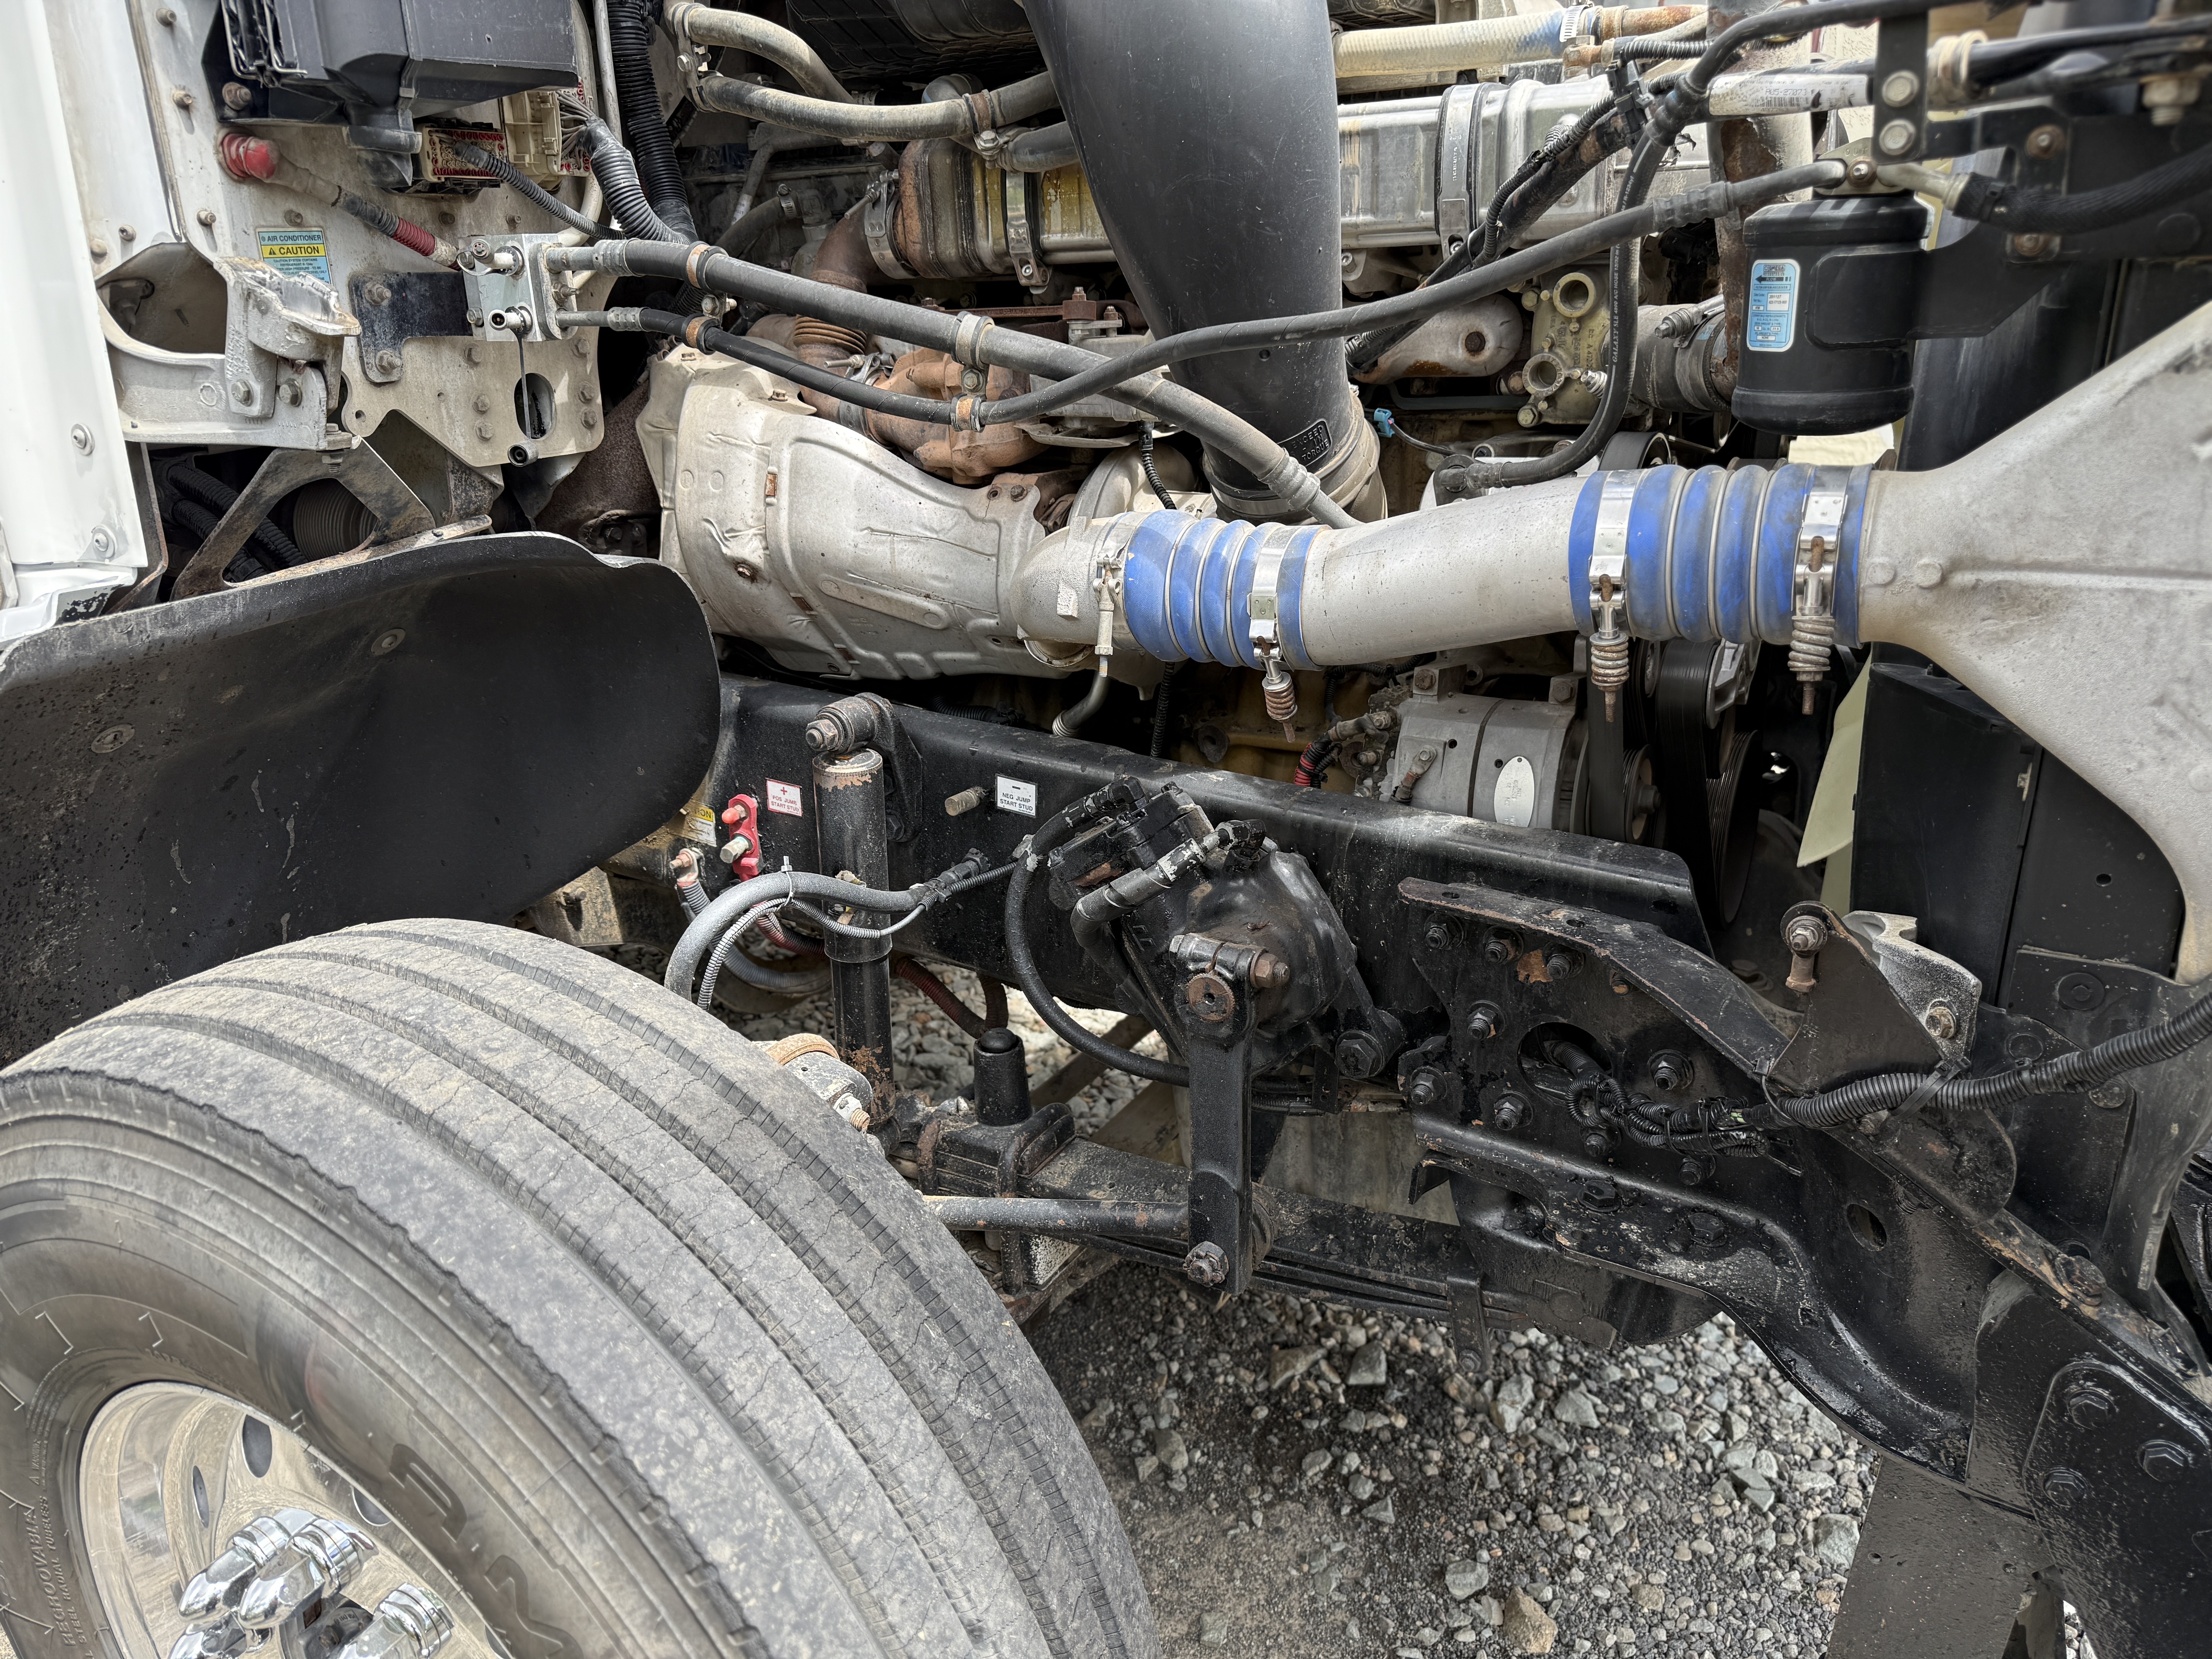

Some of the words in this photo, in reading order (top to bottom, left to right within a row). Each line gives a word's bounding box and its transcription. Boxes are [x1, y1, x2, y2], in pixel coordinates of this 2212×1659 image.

[1844, 148, 1868, 156] OUT
[279, 246, 319, 255] CAUTION
[1291, 424, 1323, 449] EXCEED
[1314, 433, 1324, 446] IN
[1302, 438, 1329, 462] TORQUE
[1000, 799, 1017, 807] START
[1018, 803, 1033, 811] STUD
[40, 1495, 56, 1550] TUBELESS
[25, 1513, 76, 1646] REGROOVABLE
[51, 1557, 71, 1601] RADIAL
[67, 1606, 87, 1644] STEEL
